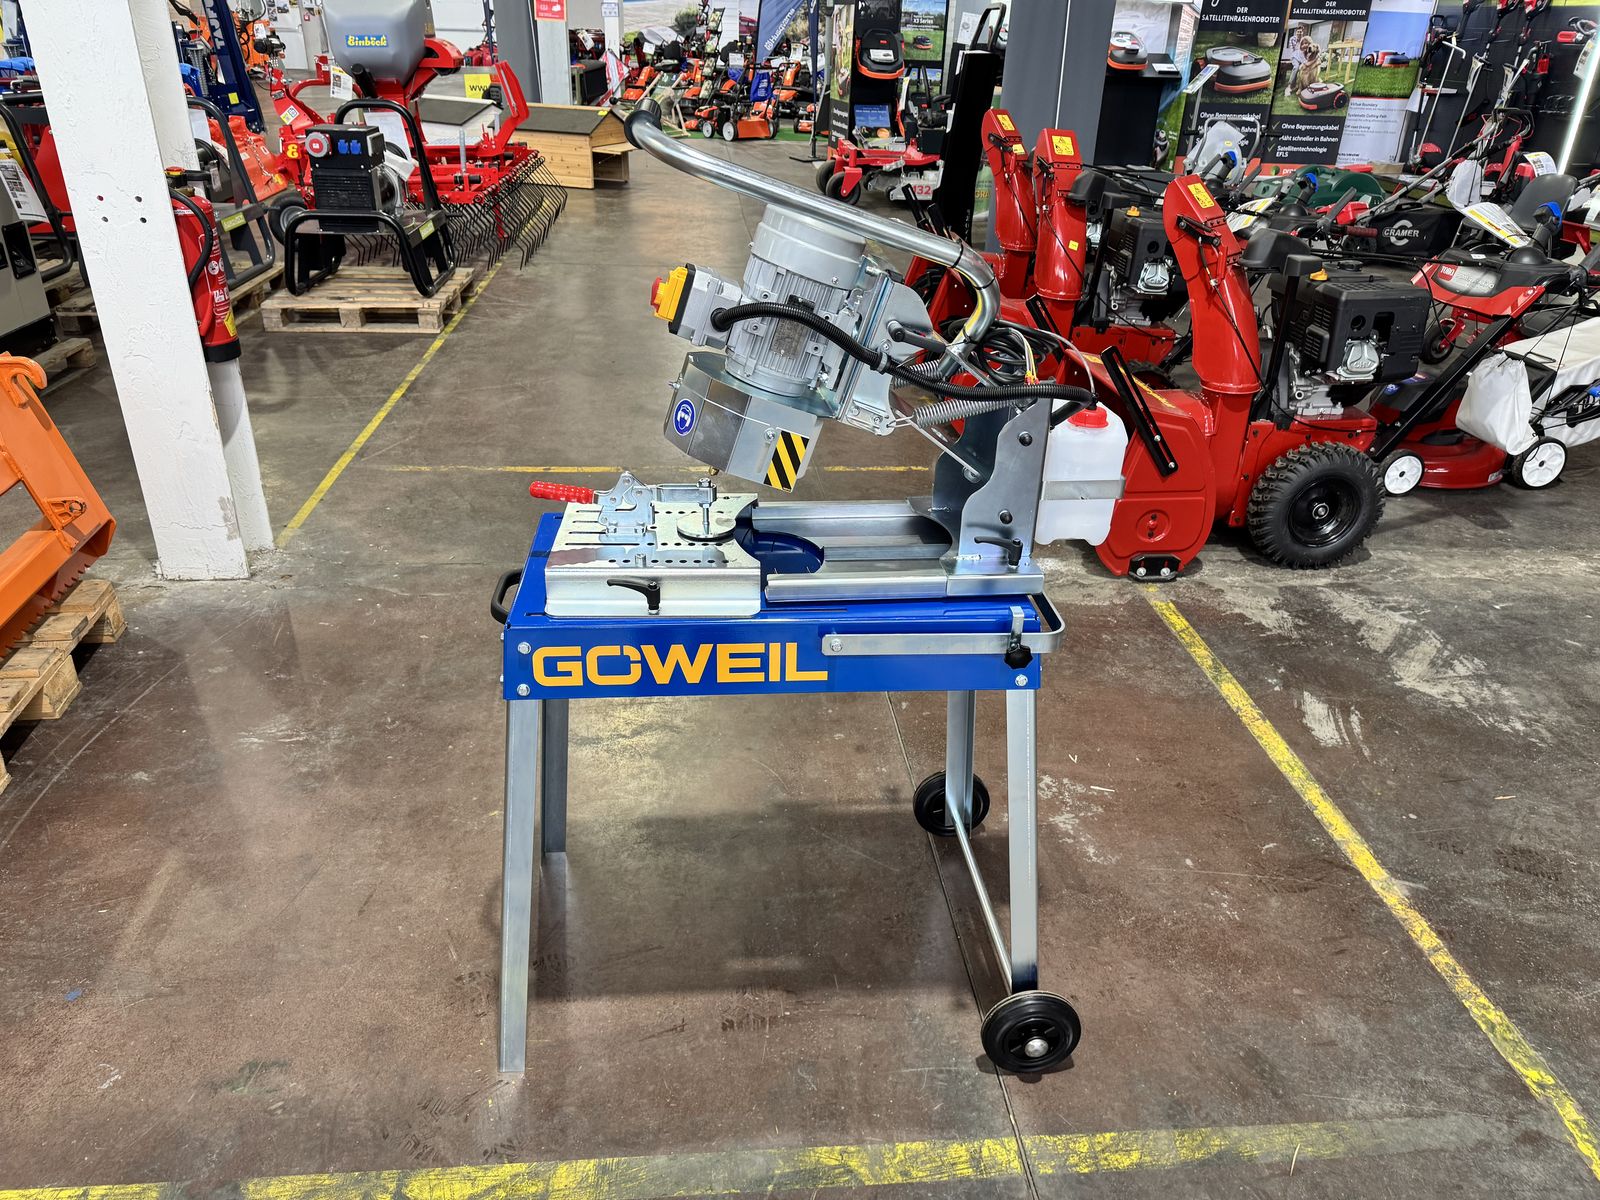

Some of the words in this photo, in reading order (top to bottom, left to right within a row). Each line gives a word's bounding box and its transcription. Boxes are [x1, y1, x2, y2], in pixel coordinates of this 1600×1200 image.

[1236, 6, 1248, 14] DER
[1293, 8, 1366, 16] SATELLITENRASENROBOTER
[1202, 14, 1280, 24] SATELLITENRASENROBOTER
[769, 8, 795, 43] Husqvarna
[1295, 123, 1340, 131] Begrenzungskabel
[1277, 145, 1327, 153] Satellitentechnologie
[1384, 228, 1420, 238] CRAMER
[1440, 265, 1455, 276] TORO
